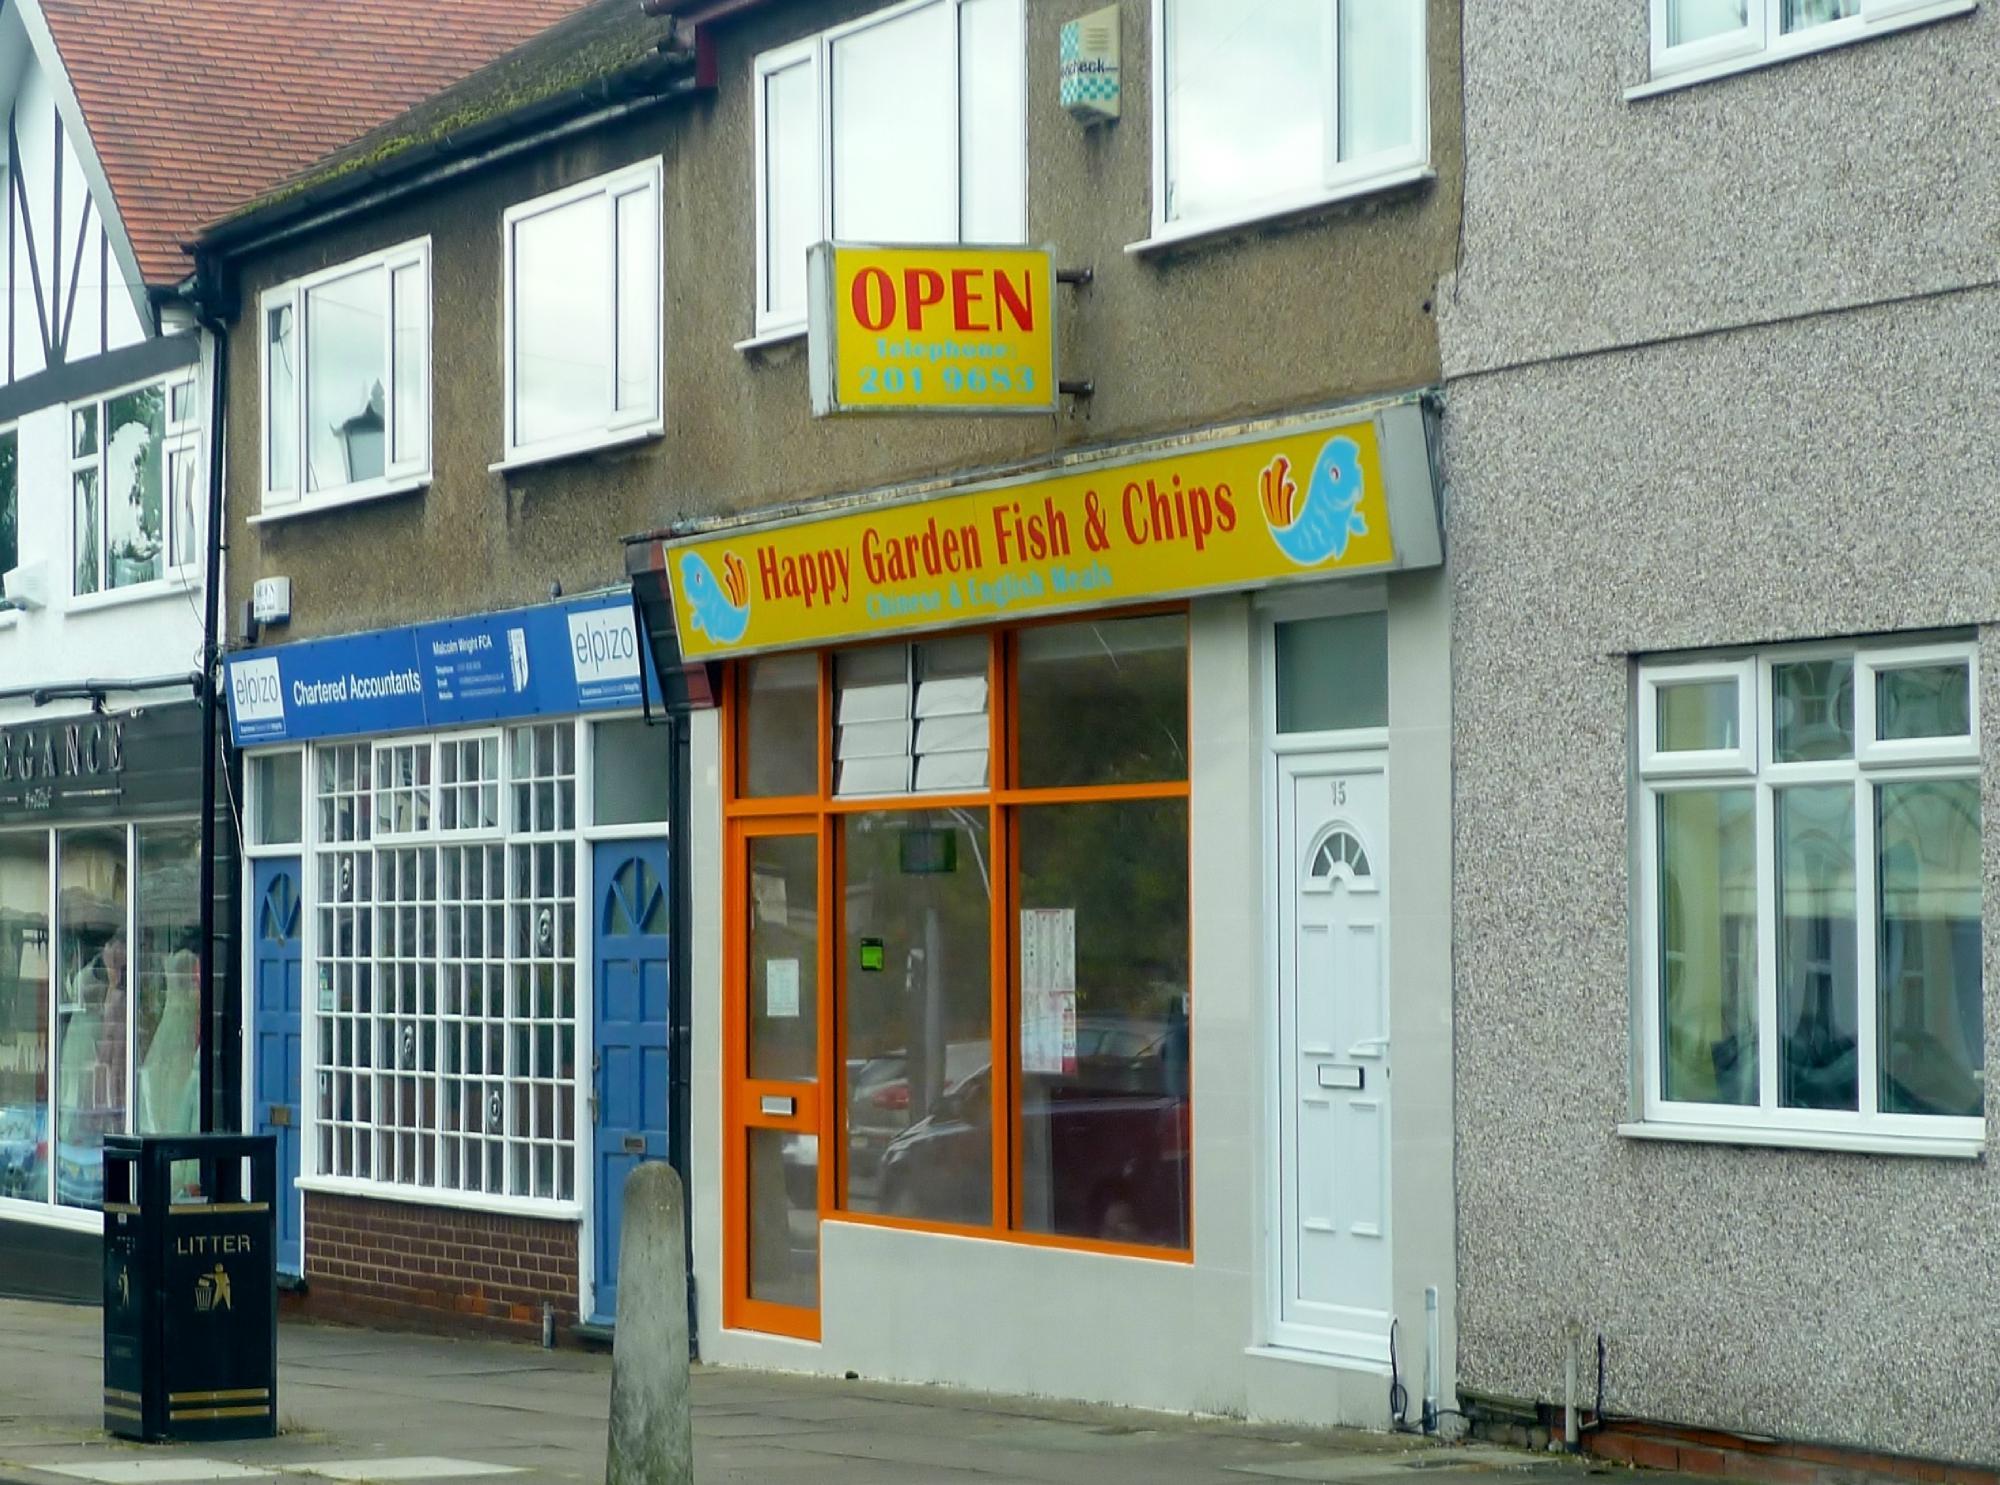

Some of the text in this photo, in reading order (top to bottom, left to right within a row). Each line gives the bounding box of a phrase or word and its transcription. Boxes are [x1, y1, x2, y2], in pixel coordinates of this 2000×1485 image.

[851, 265, 1034, 332] OPEN
[858, 365, 1035, 394] 201 9683
[757, 473, 1237, 608] Happy Garden Fish & Chips
[866, 559, 1113, 620] Chinese & English Meals
[478, 634, 492, 649] FCA
[576, 618, 634, 673] elpizo
[236, 667, 279, 713] elpizo
[293, 674, 347, 707] Chartered
[350, 668, 421, 700] Accountants
[1330, 780, 1347, 806] 15
[177, 1234, 251, 1255] LITTER
